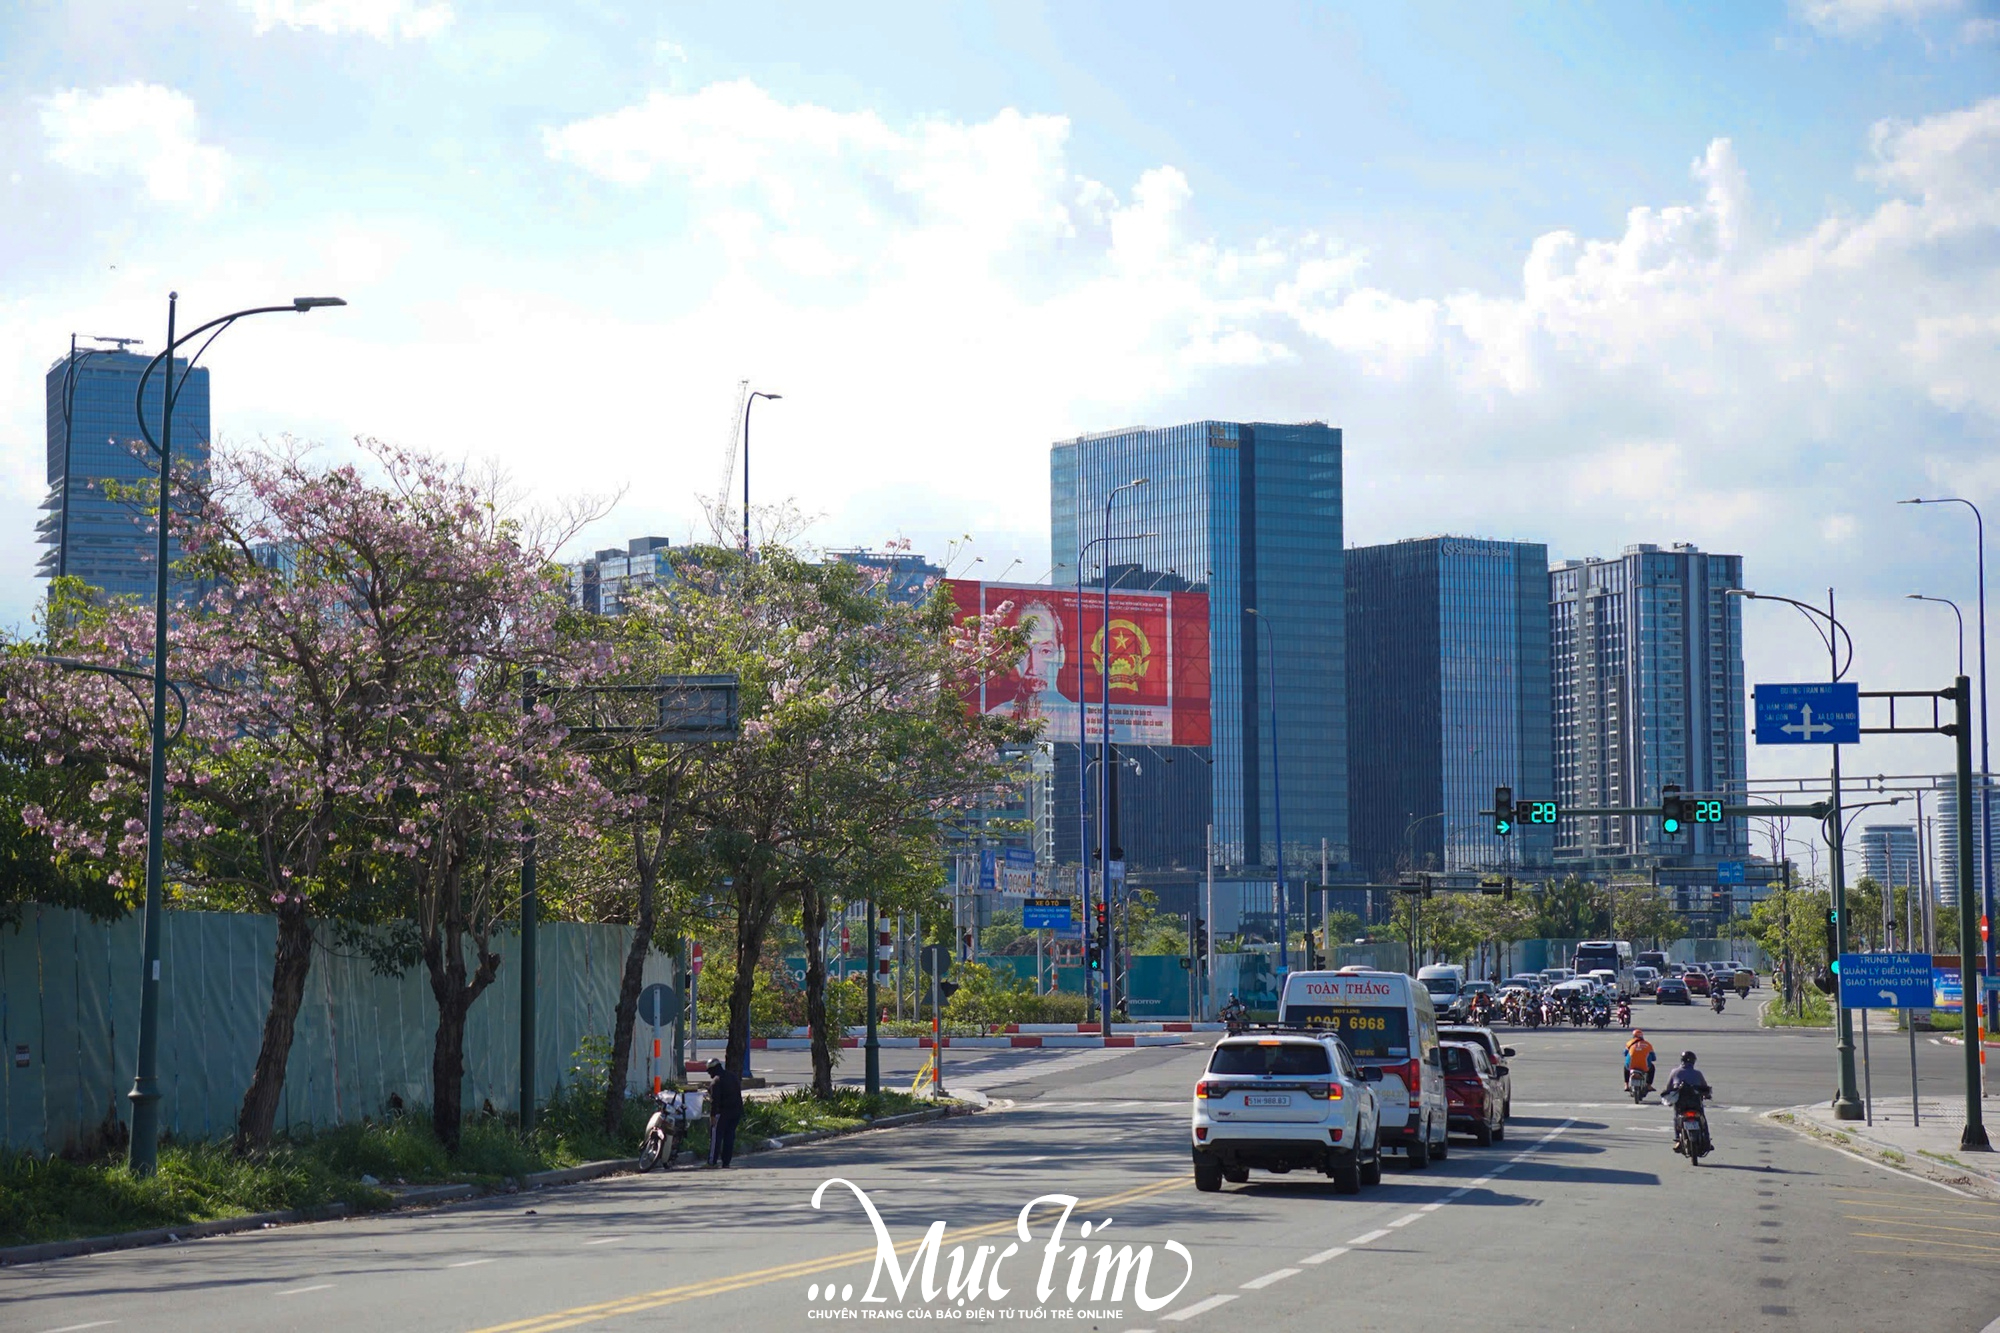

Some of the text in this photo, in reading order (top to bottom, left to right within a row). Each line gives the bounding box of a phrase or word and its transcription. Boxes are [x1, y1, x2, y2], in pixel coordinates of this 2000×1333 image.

[1454, 544, 1511, 557] Shinhan Bank
[1531, 802, 1557, 823] 28
[1695, 801, 1722, 823] 28
[1860, 954, 1910, 964] TRUNG TÂM
[1843, 965, 1928, 975] QUẢN LÝ ĐIỀU HÀNH
[1306, 981, 1339, 995] TOÀN
[1845, 977, 1929, 988] GIAO THÔNG ĐÔ THỊ
[1349, 1016, 1385, 1031] 6968
